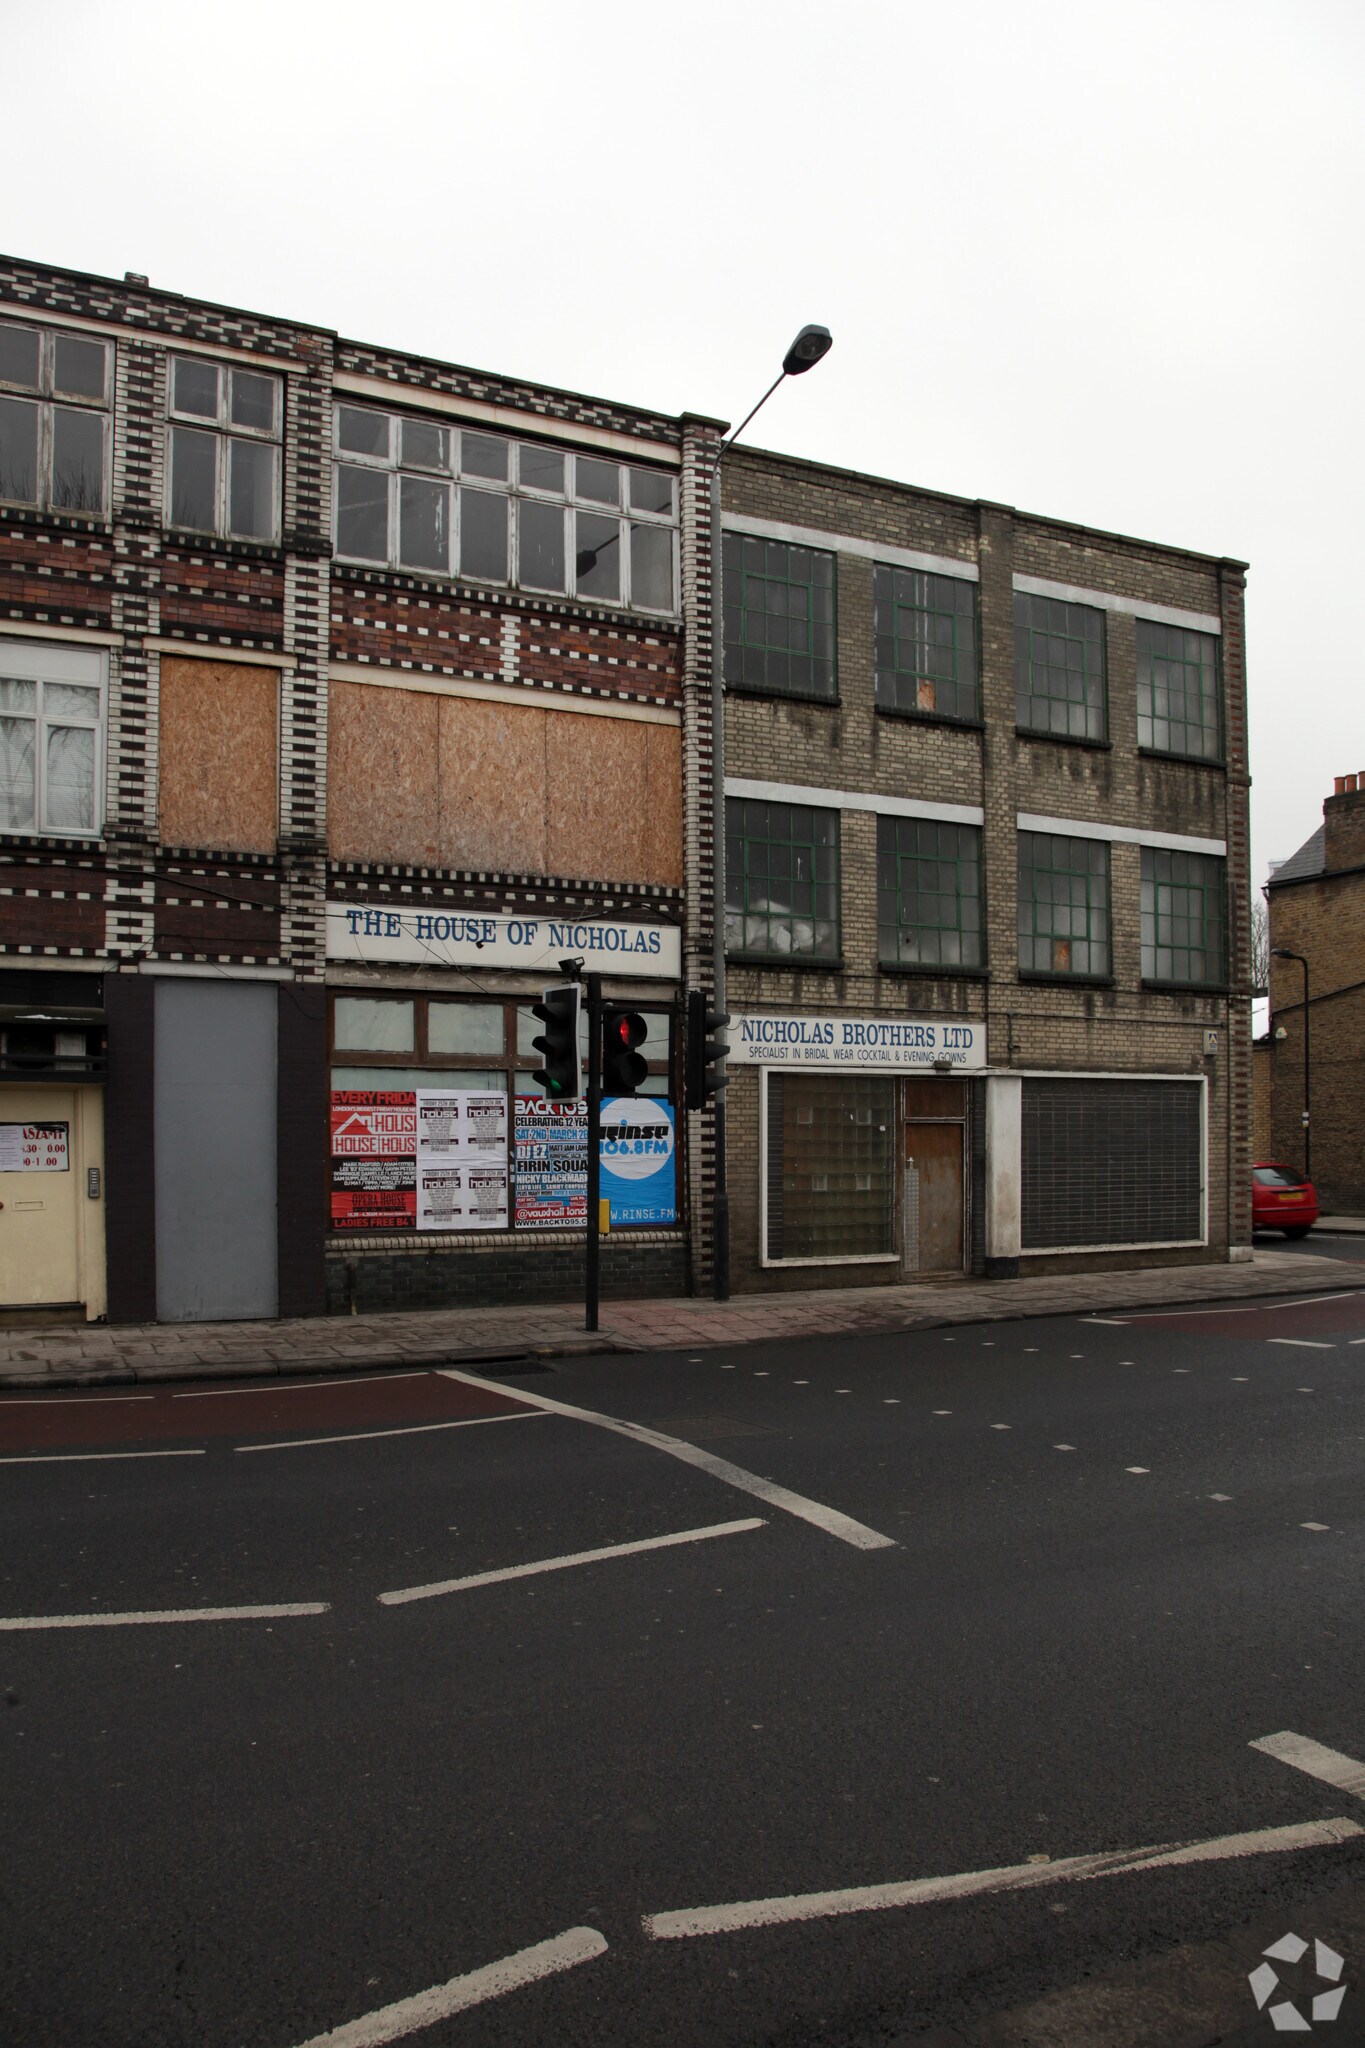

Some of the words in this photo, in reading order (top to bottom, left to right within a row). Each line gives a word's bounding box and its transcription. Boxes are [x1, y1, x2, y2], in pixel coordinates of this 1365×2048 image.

[347, 910, 400, 937] THE
[416, 915, 496, 943] HOUSE
[507, 921, 538, 945] OF
[549, 924, 661, 953] NICHOLAS
[741, 1020, 834, 1045] NICHOLAS
[842, 1023, 936, 1048] BROTHERS
[943, 1027, 973, 1049] LTD
[749, 1047, 789, 1059] SPECIALIST
[793, 1048, 801, 1058] IN
[805, 1048, 829, 1060] BRIDAL
[833, 1049, 854, 1060] WEAR
[857, 1049, 891, 1061] COCKTAIL
[895, 1050, 900, 1061] &
[904, 1051, 935, 1063] EVENING
[938, 1052, 967, 1064] GOWNS
[331, 1091, 375, 1105] EVERY
[422, 1109, 457, 1118] house
[468, 1108, 503, 1117] house
[515, 1117, 564, 1127] CELEBRATING
[565, 1117, 573, 1126] 12
[515, 1129, 530, 1140] SAT
[531, 1129, 547, 1140] 2ND
[549, 1129, 577, 1140] MARCH
[335, 1137, 377, 1152] HOUSE
[382, 1136, 417, 1152] HOUS
[517, 1160, 551, 1172] FIRIN
[424, 1180, 460, 1188] house
[470, 1180, 505, 1188] house
[516, 1174, 541, 1184] NICKY
[352, 1193, 378, 1206] OPERA
[380, 1193, 406, 1206] HOUSE
[517, 1207, 565, 1220] @vauxhall
[334, 1218, 368, 1228] LADIES
[370, 1218, 394, 1227] FREE
